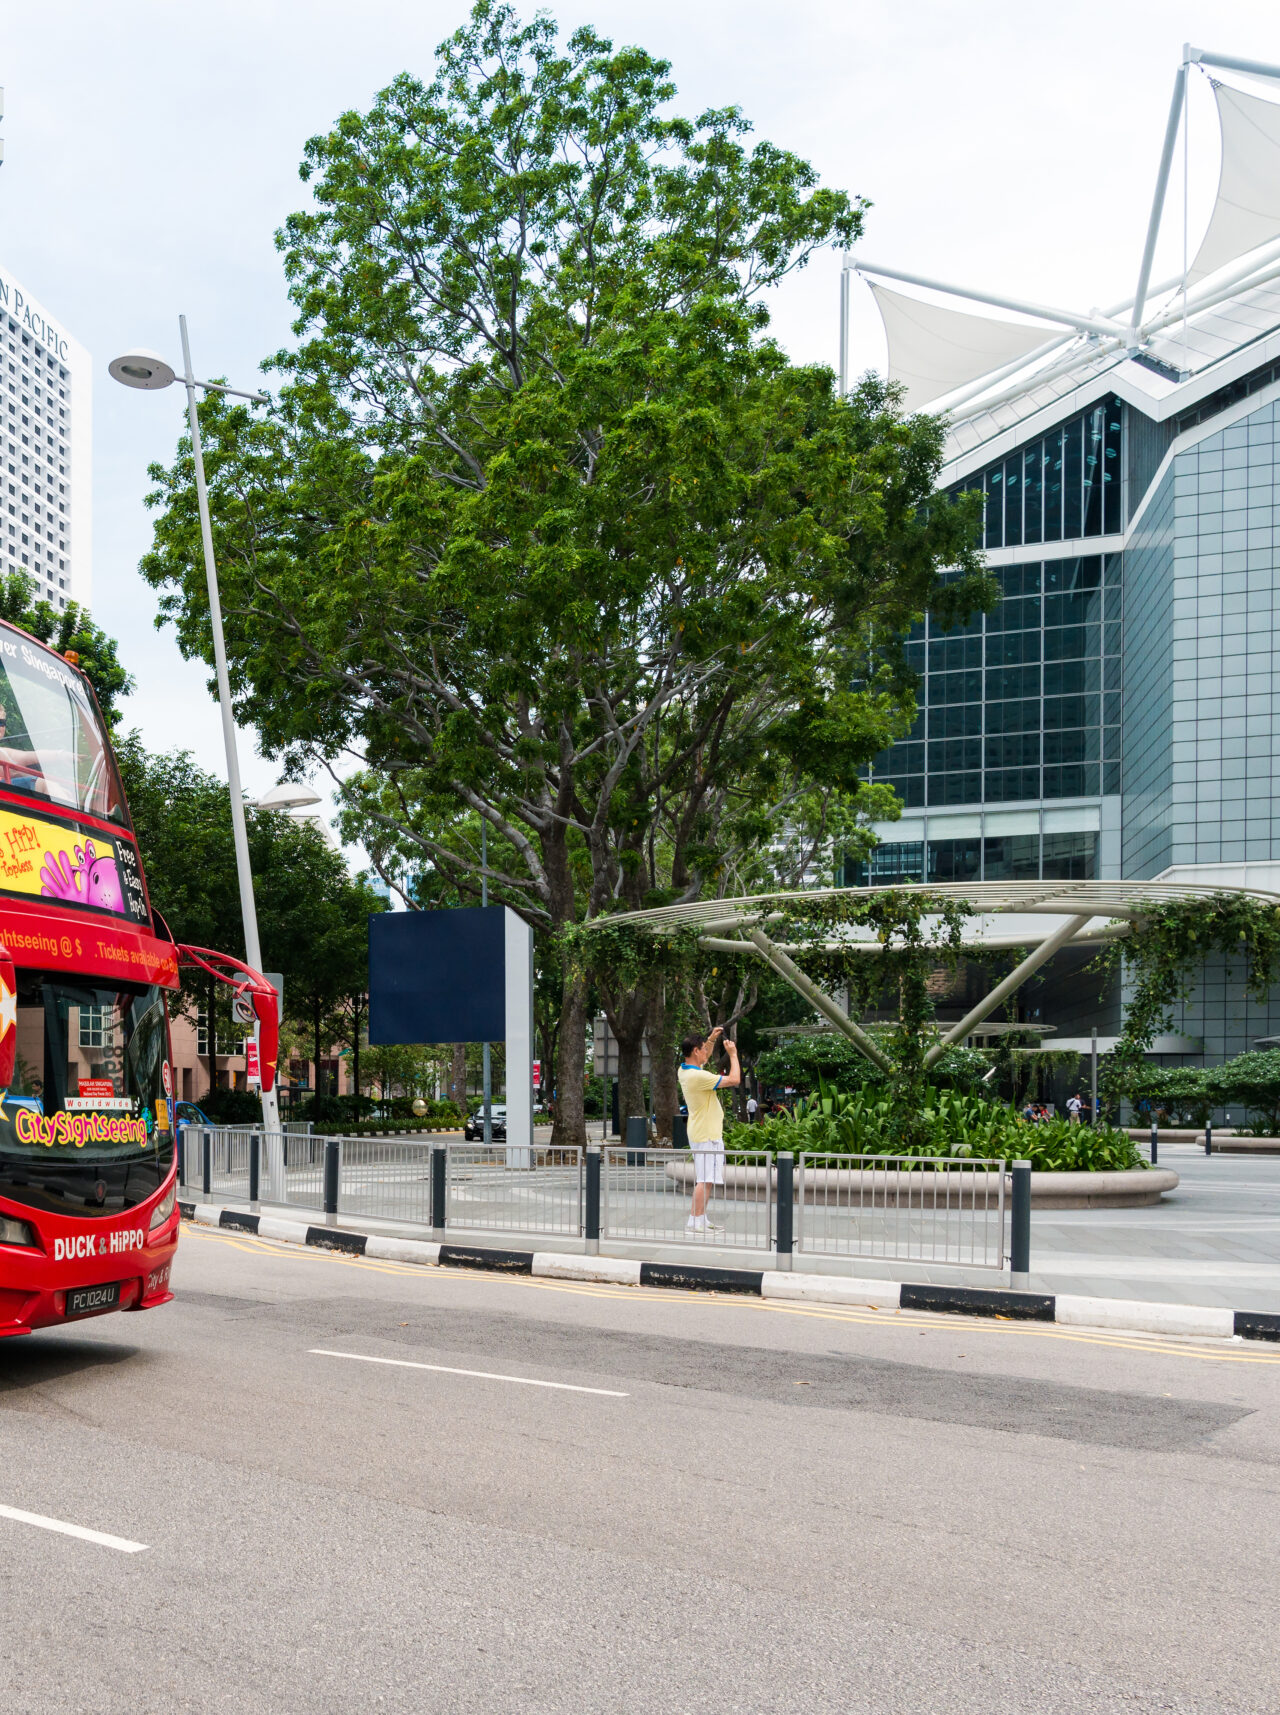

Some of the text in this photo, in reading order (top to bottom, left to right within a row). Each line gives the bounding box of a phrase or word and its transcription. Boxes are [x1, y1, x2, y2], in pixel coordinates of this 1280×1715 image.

[14, 288, 68, 361] PACIFIC
[116, 841, 136, 867] Free
[1, 858, 33, 879] Topless
[60, 936, 73, 957] @
[75, 938, 82, 957] $
[130, 951, 160, 969] available
[67, 1099, 129, 1107] Worldwide
[16, 1108, 148, 1148] CitySightseeing
[54, 1234, 96, 1261] DUCK
[98, 1237, 107, 1255] &
[73, 1288, 115, 1310] PC1024U
